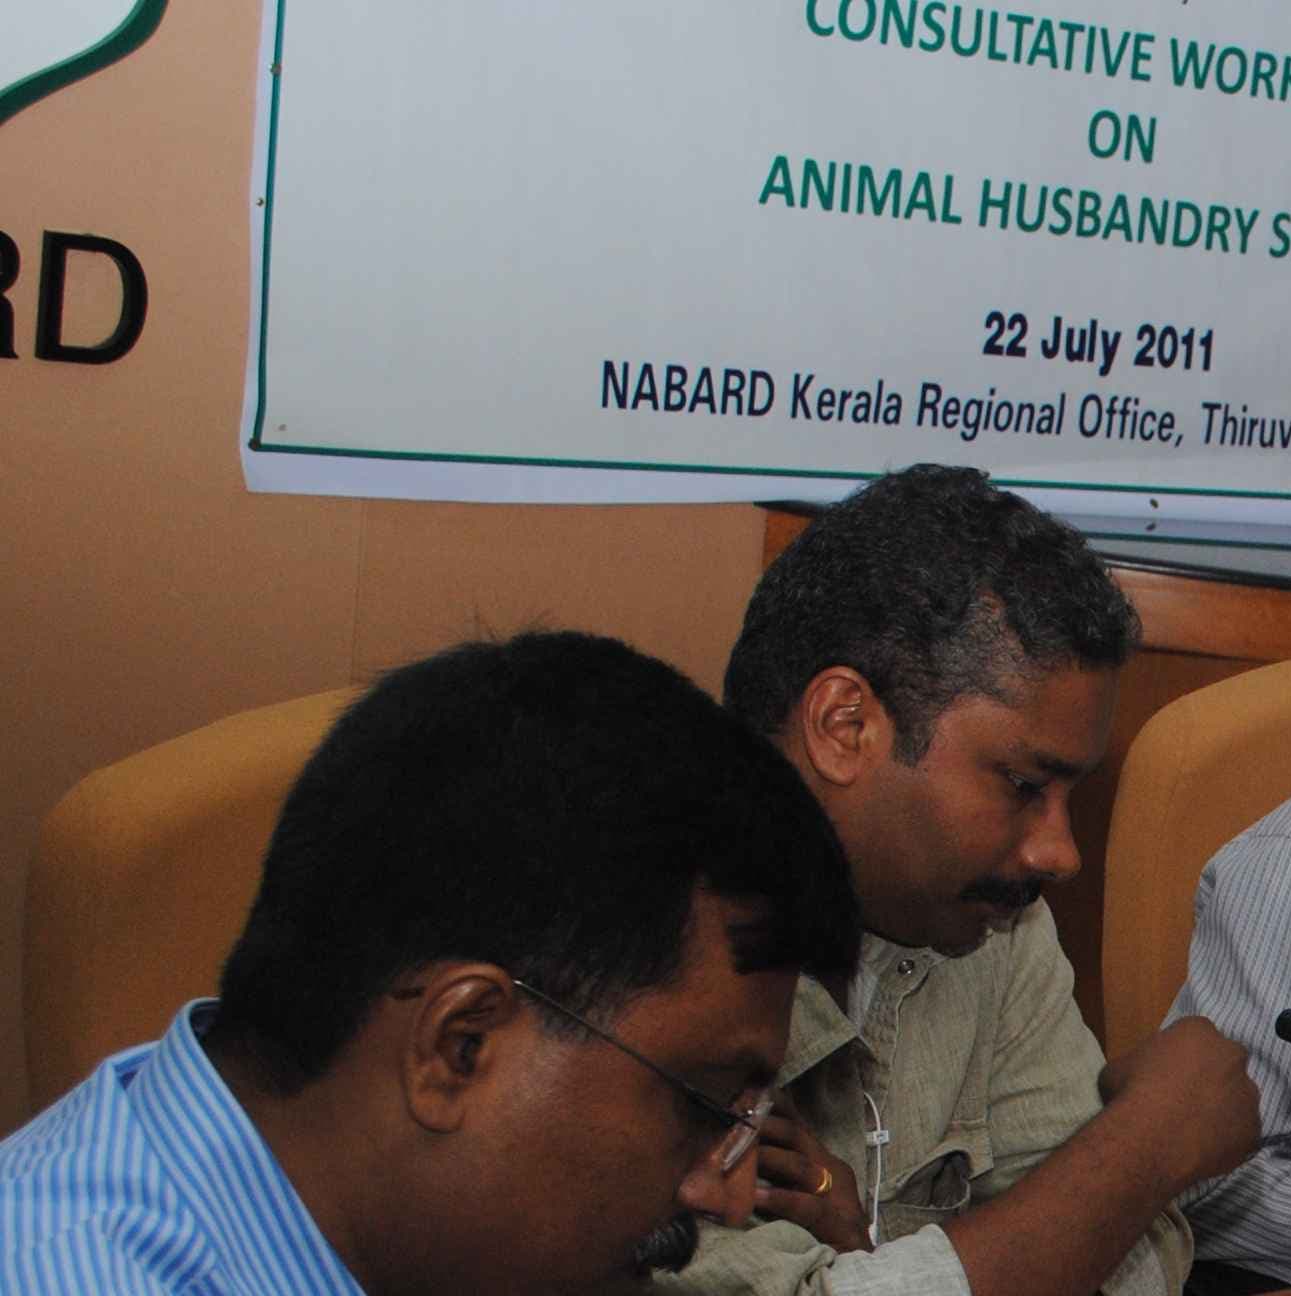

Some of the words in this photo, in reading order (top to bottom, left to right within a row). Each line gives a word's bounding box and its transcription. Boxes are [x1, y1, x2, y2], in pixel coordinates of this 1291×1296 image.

[805, 0, 1155, 81] CONSULTATIVE
[1088, 110, 1157, 163] ON
[759, 155, 962, 224] ANIMAL
[978, 178, 1260, 255] HUSBANDRY
[982, 310, 1027, 358] 22
[1041, 316, 1121, 376] July
[1133, 323, 1214, 371] 2011
[601, 360, 775, 416] NABARD
[789, 373, 902, 425] Kerala
[916, 382, 1066, 442] Regional
[1078, 393, 1183, 448] Office,
